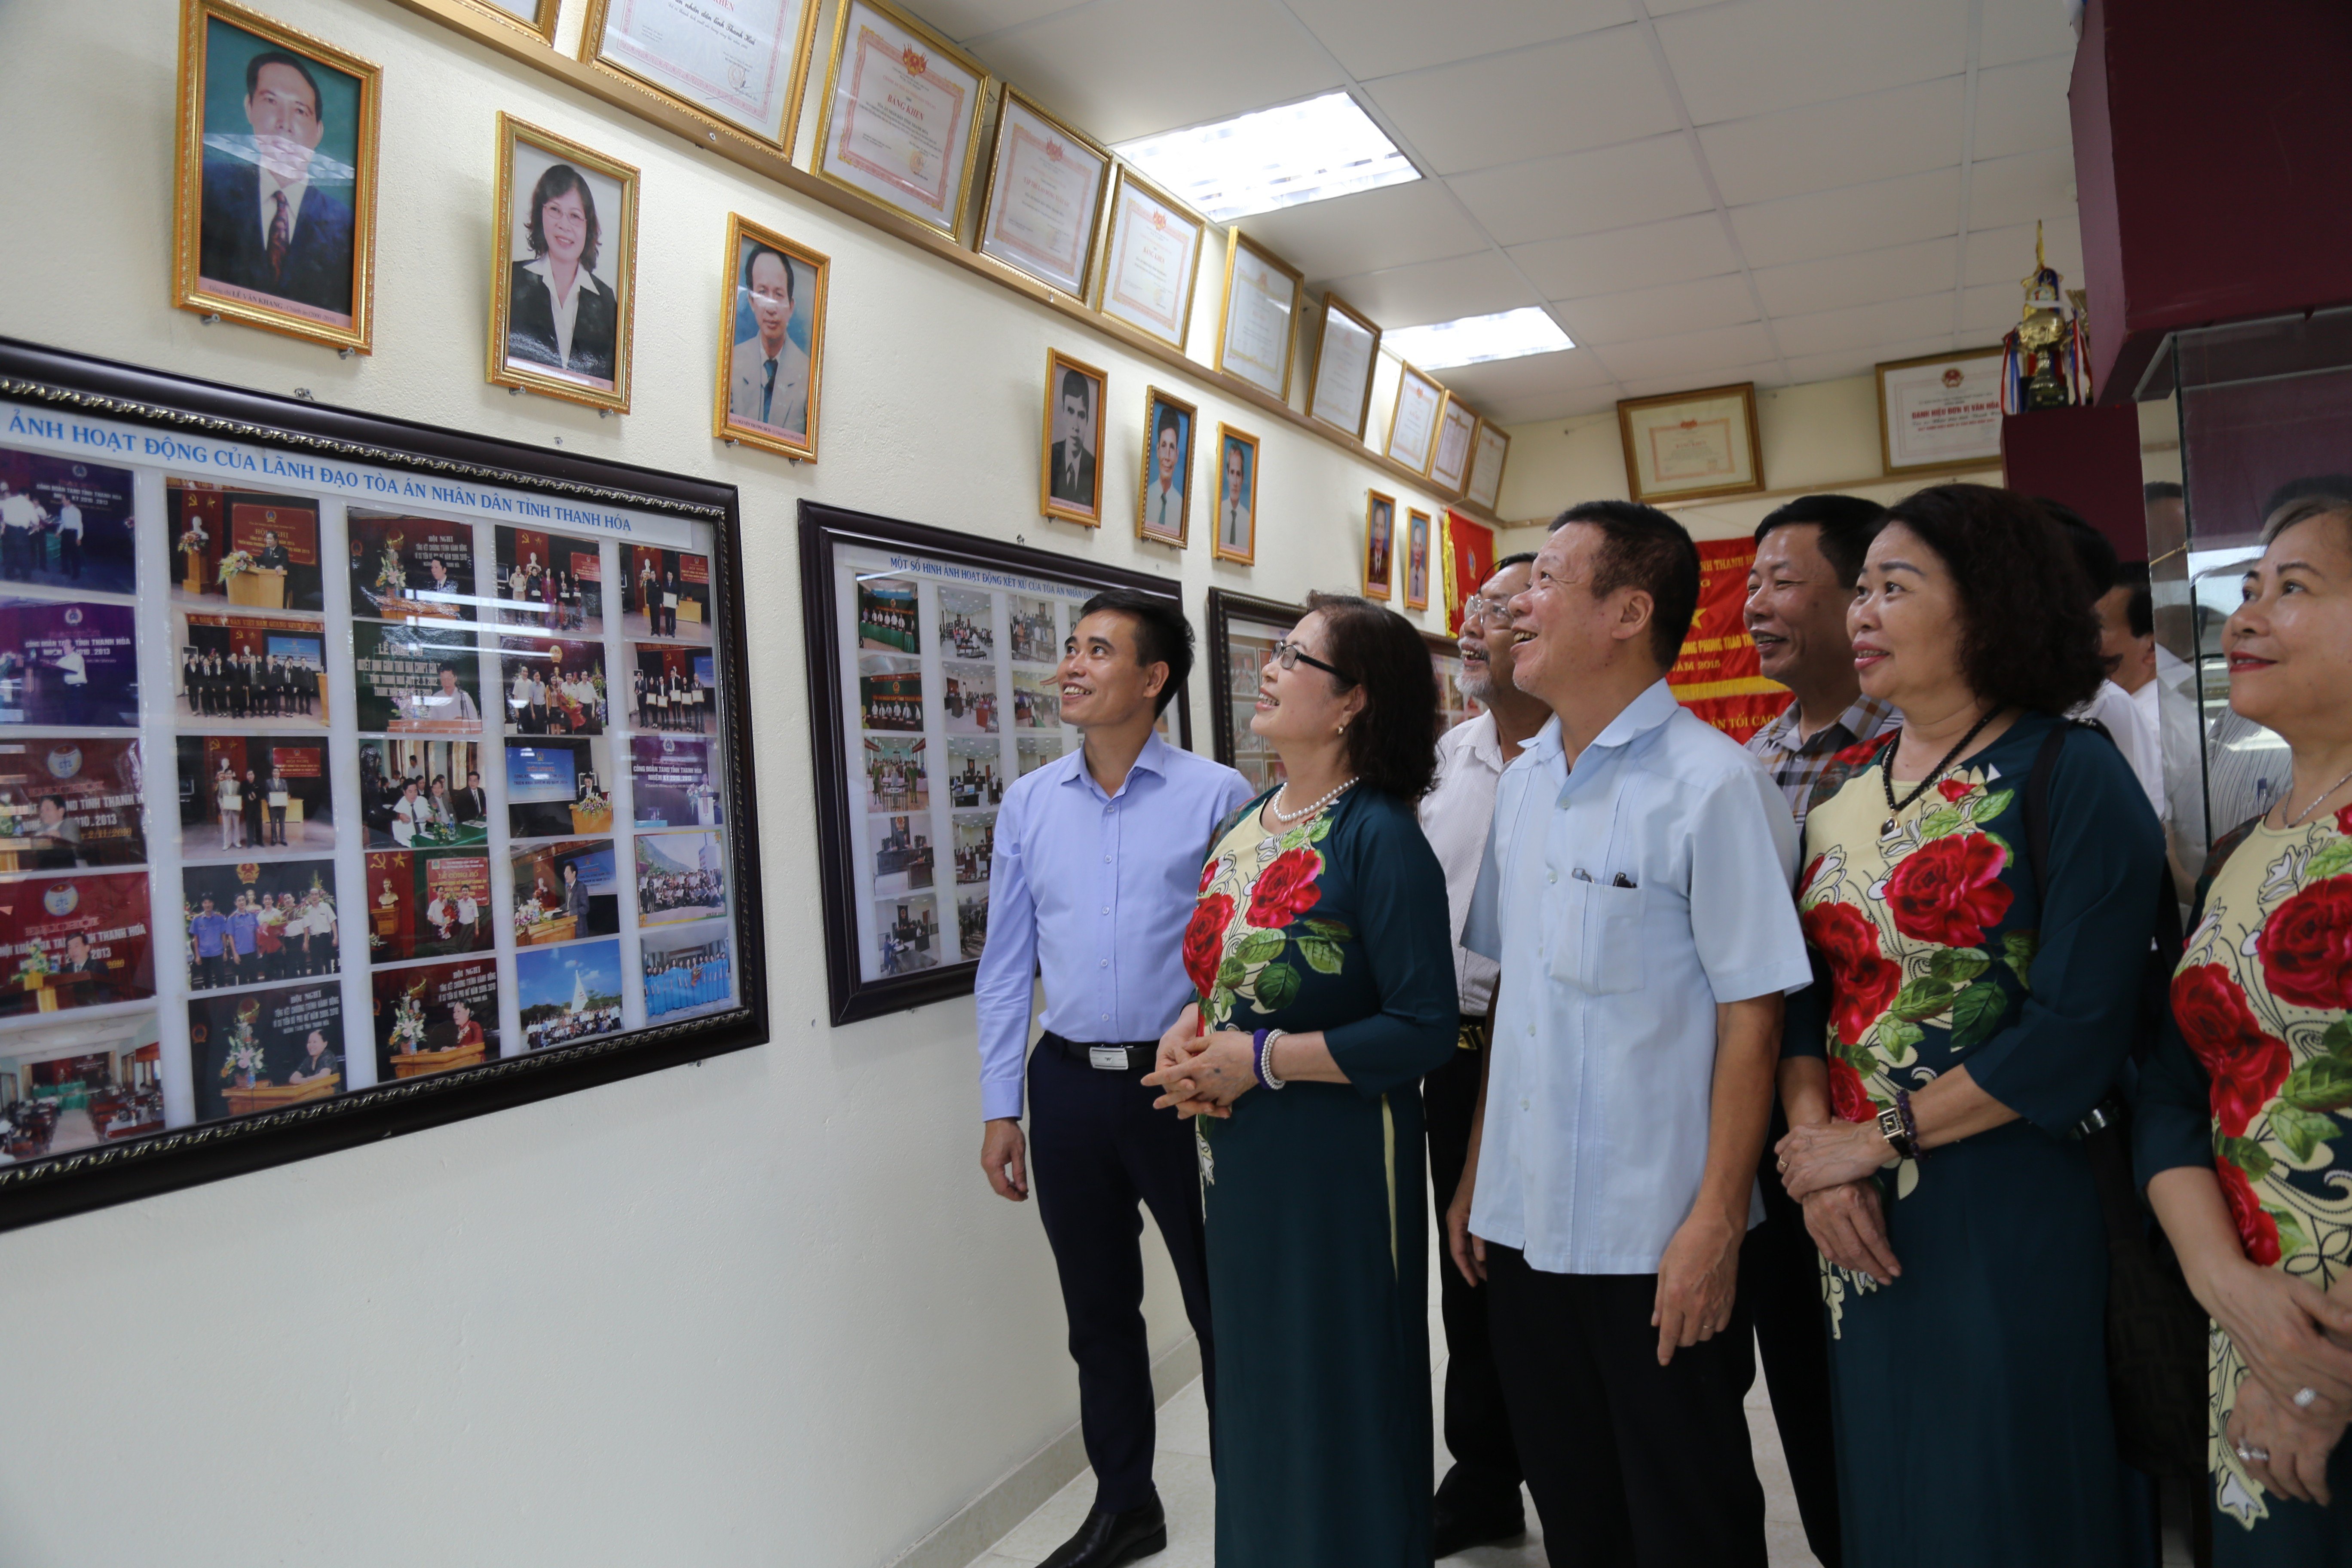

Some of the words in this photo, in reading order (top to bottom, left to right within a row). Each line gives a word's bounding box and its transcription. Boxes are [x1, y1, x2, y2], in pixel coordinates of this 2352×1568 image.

[259, 297, 283, 309] KHANG
[9, 409, 64, 440] ẢNH
[73, 426, 136, 452] HOẠT
[145, 437, 207, 463] ĐỘNG
[214, 447, 256, 472] CỦA
[263, 456, 314, 480] LÃNH
[321, 468, 358, 488] ĐẠO
[364, 473, 398, 494] TÒA
[404, 478, 426, 498] ÁN
[432, 486, 475, 506] NHÂN
[481, 493, 512, 512] DÂN
[517, 497, 550, 518] TỈNH
[555, 507, 600, 526] THANH
[604, 514, 632, 531] HÓA
[1714, 557, 1743, 571] THANH
[890, 556, 907, 570] MỘT
[910, 557, 921, 572] SỐ
[923, 562, 941, 575] HÌNH
[943, 564, 959, 578] ẢNH
[962, 570, 980, 583] HOẠT
[983, 572, 1002, 585] ĐỘNG
[1003, 575, 1017, 587] XÉT
[1018, 578, 1028, 589] XỬ
[1029, 580, 1041, 592] CỦA
[1057, 585, 1065, 596] ÁN
[1066, 587, 1083, 599] NHÂN
[104, 794, 134, 808] THANH
[95, 814, 117, 825] 2013
